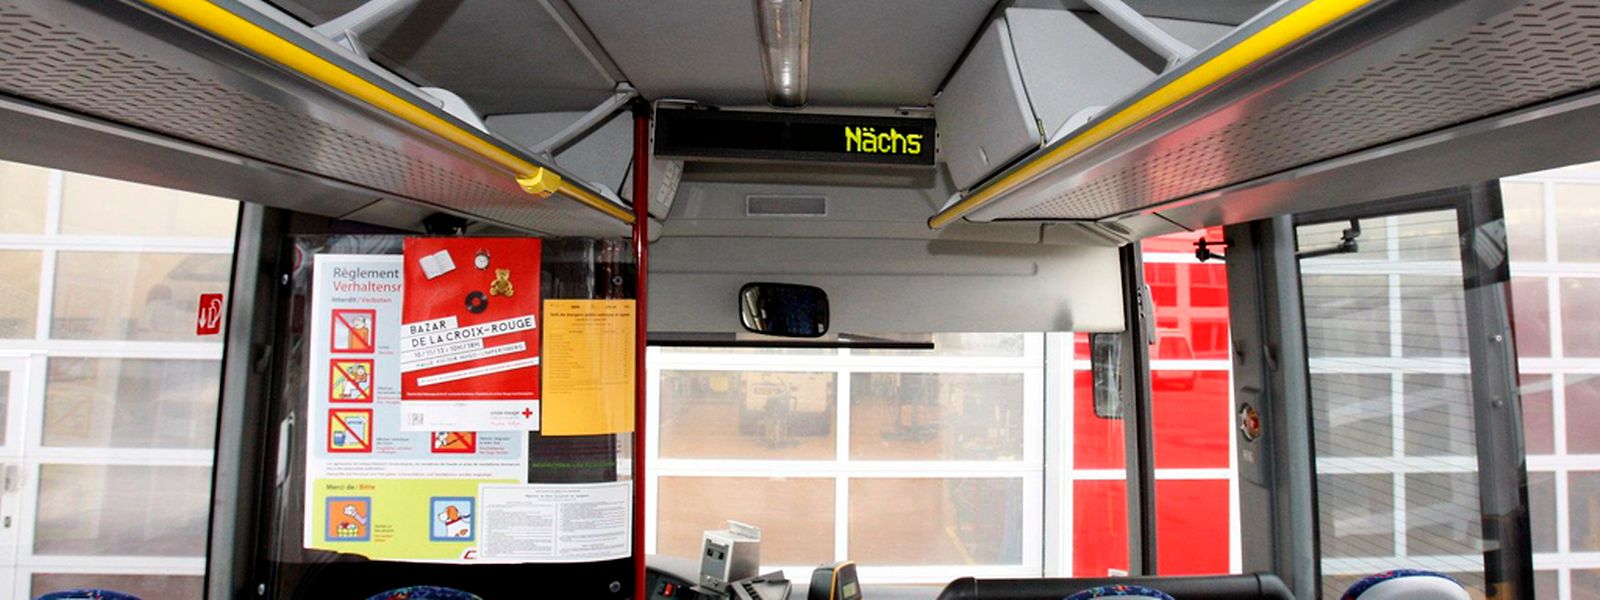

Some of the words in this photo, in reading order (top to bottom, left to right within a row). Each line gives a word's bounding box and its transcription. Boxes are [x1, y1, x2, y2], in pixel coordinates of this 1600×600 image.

[845, 126, 923, 154] Nächs
[334, 267, 399, 280] Règlement
[410, 320, 447, 335] BAZAR
[412, 338, 427, 348] DE
[430, 335, 444, 345] LA
[446, 317, 533, 341] CROIX-ROUGE
